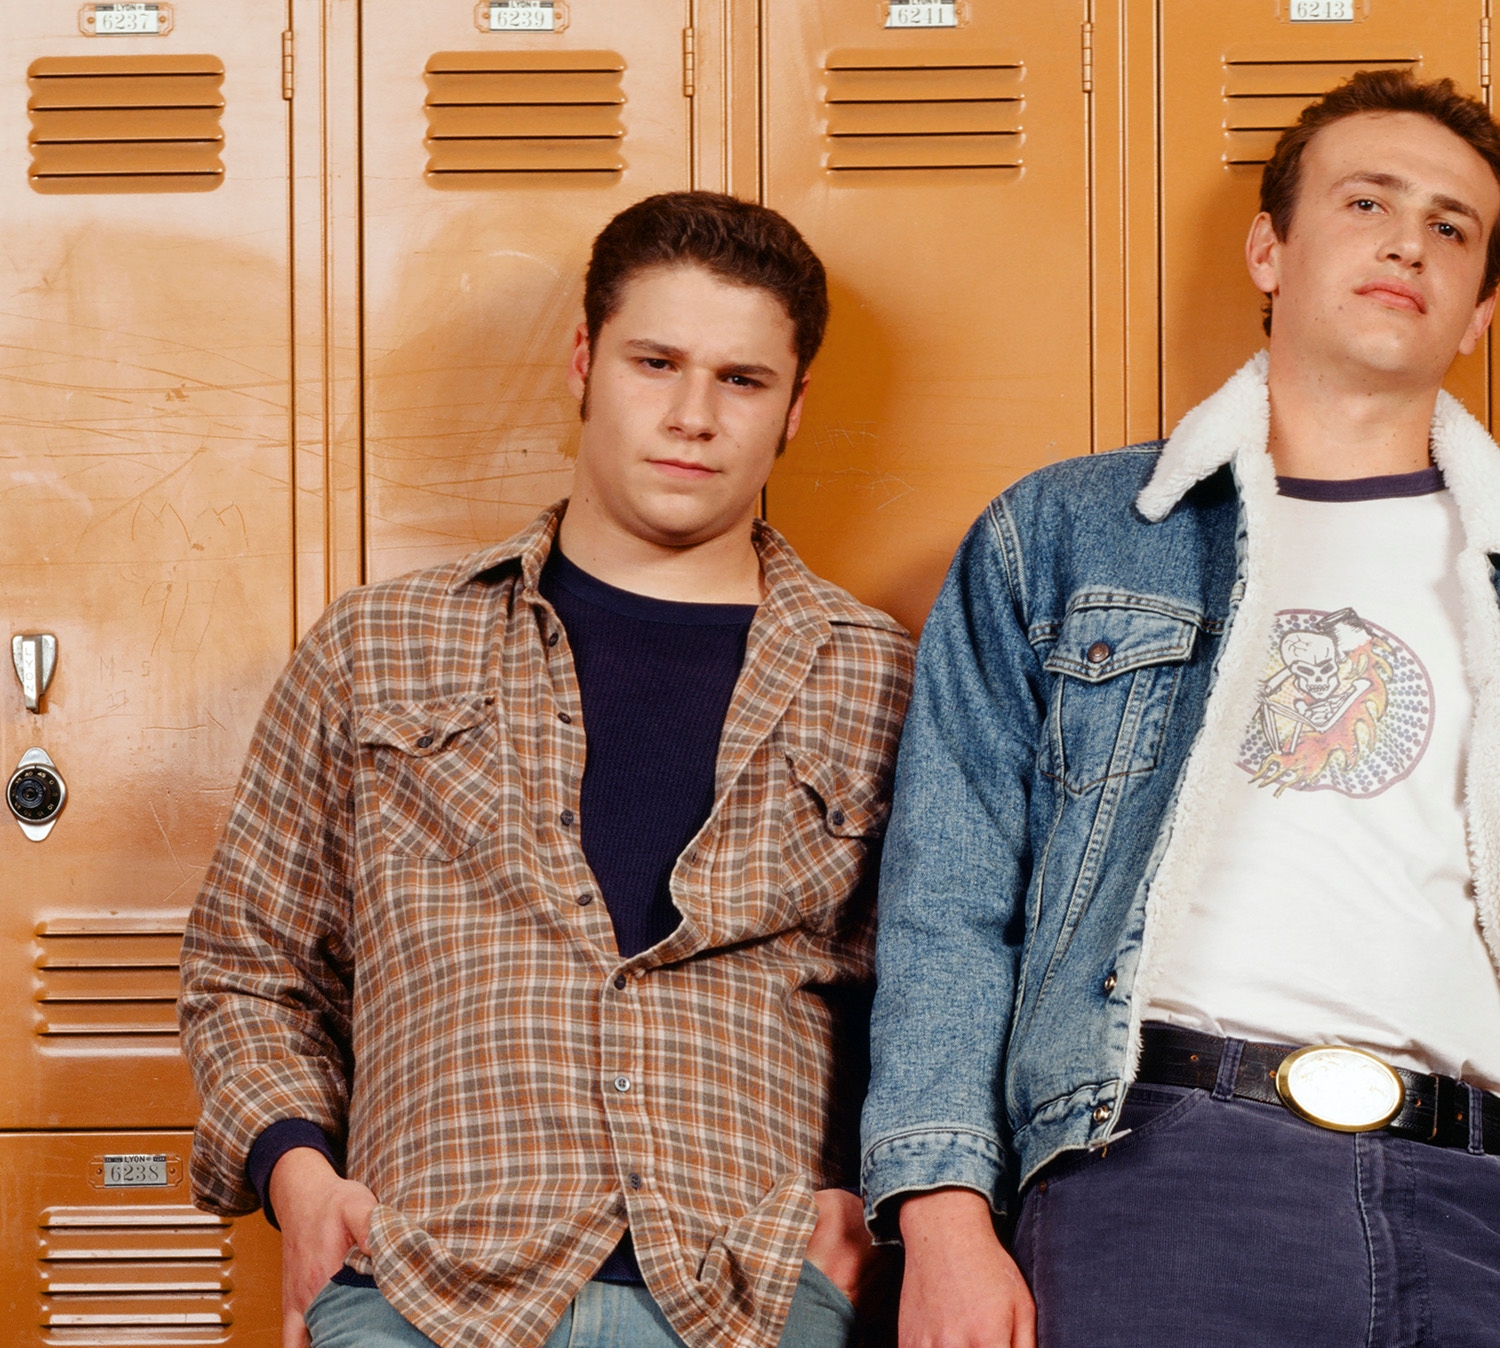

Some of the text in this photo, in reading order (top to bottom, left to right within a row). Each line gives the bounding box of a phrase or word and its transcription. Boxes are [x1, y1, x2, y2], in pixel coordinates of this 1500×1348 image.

[103, 13, 148, 30] 6237
[497, 10, 544, 27] 6239
[24, 647, 35, 693] LYON
[111, 1165, 159, 1182] 6238
